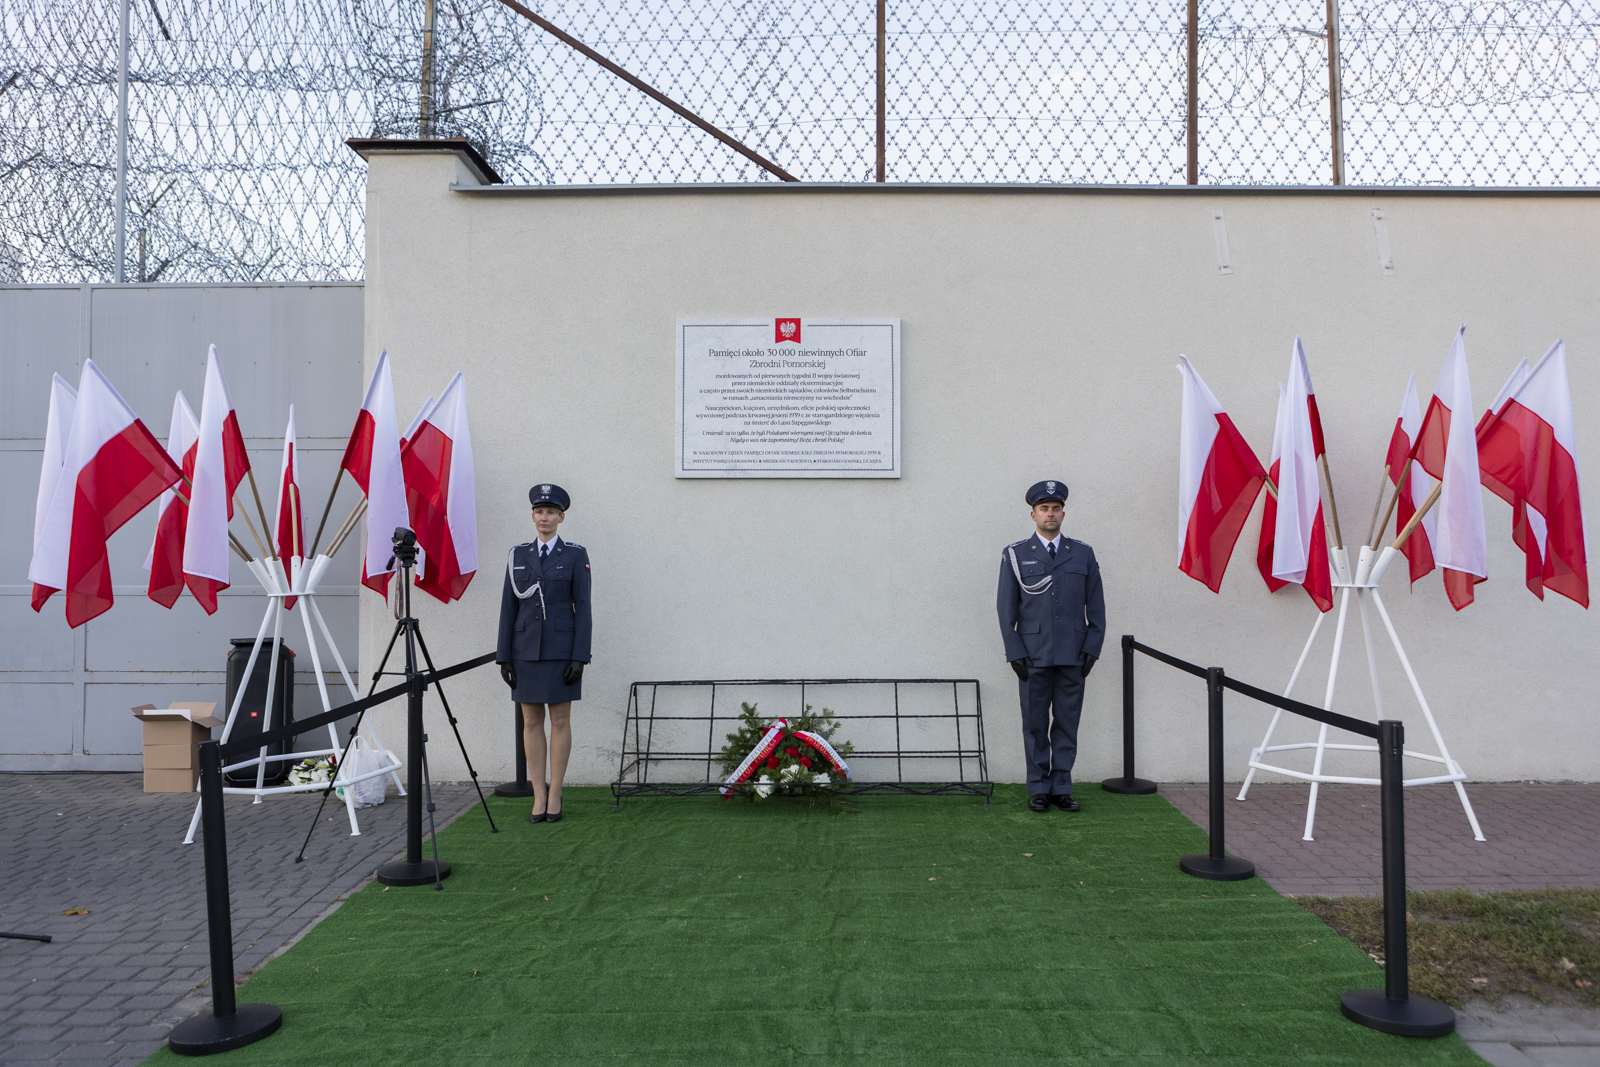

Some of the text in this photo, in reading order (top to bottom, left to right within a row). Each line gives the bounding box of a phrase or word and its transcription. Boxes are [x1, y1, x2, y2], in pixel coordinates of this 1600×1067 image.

[709, 348, 867, 358] Pamięci około 30 000 niewinnych Ofiar
[782, 360, 825, 369] Pomorskiej
